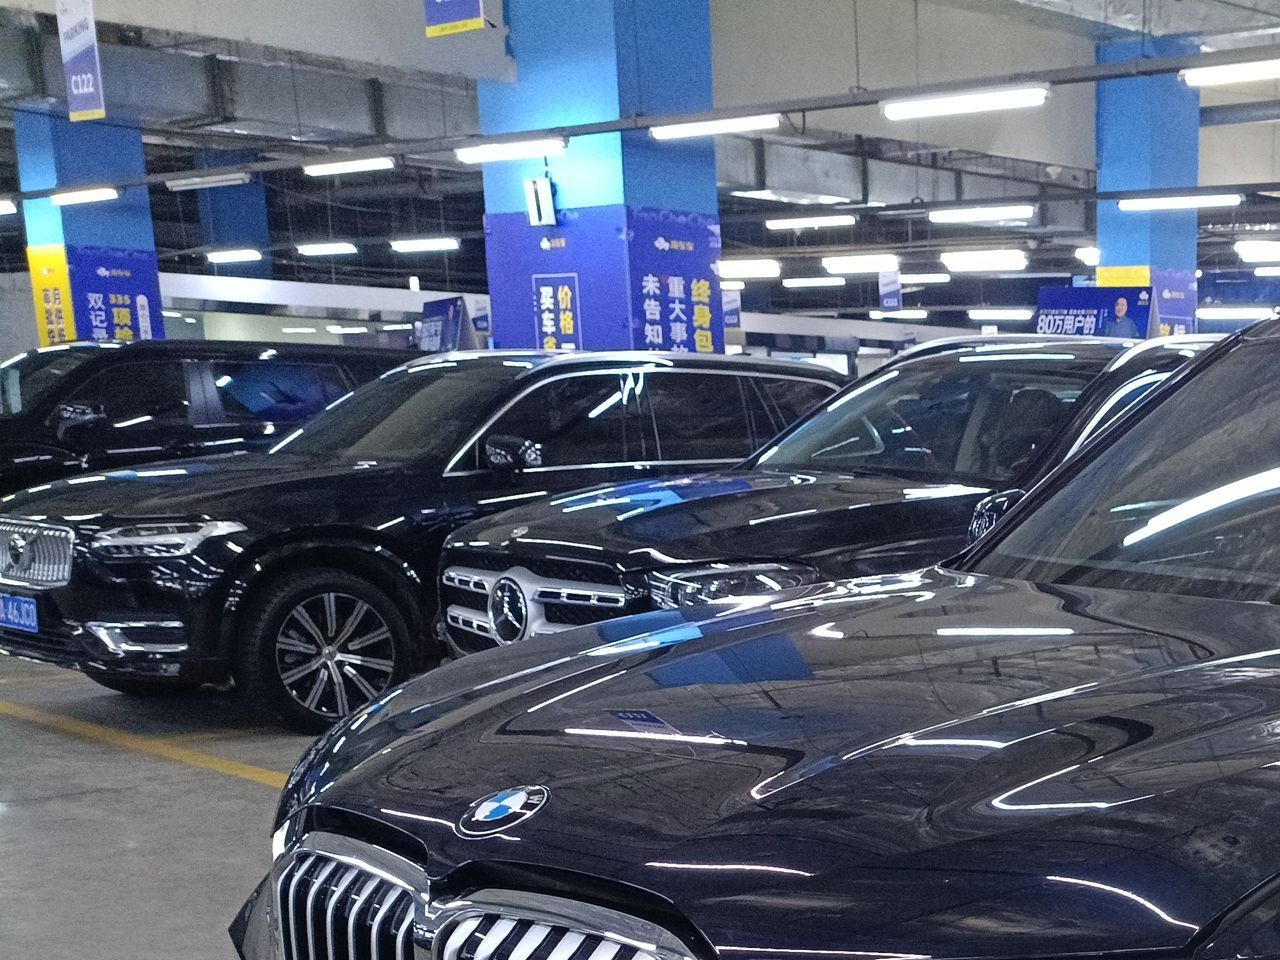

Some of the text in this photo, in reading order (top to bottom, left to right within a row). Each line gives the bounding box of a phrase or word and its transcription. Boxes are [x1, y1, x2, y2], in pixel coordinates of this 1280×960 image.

[71, 72, 95, 95] C122
[642, 273, 663, 350] 未告知
[1037, 314, 1096, 334] 80万用户的
